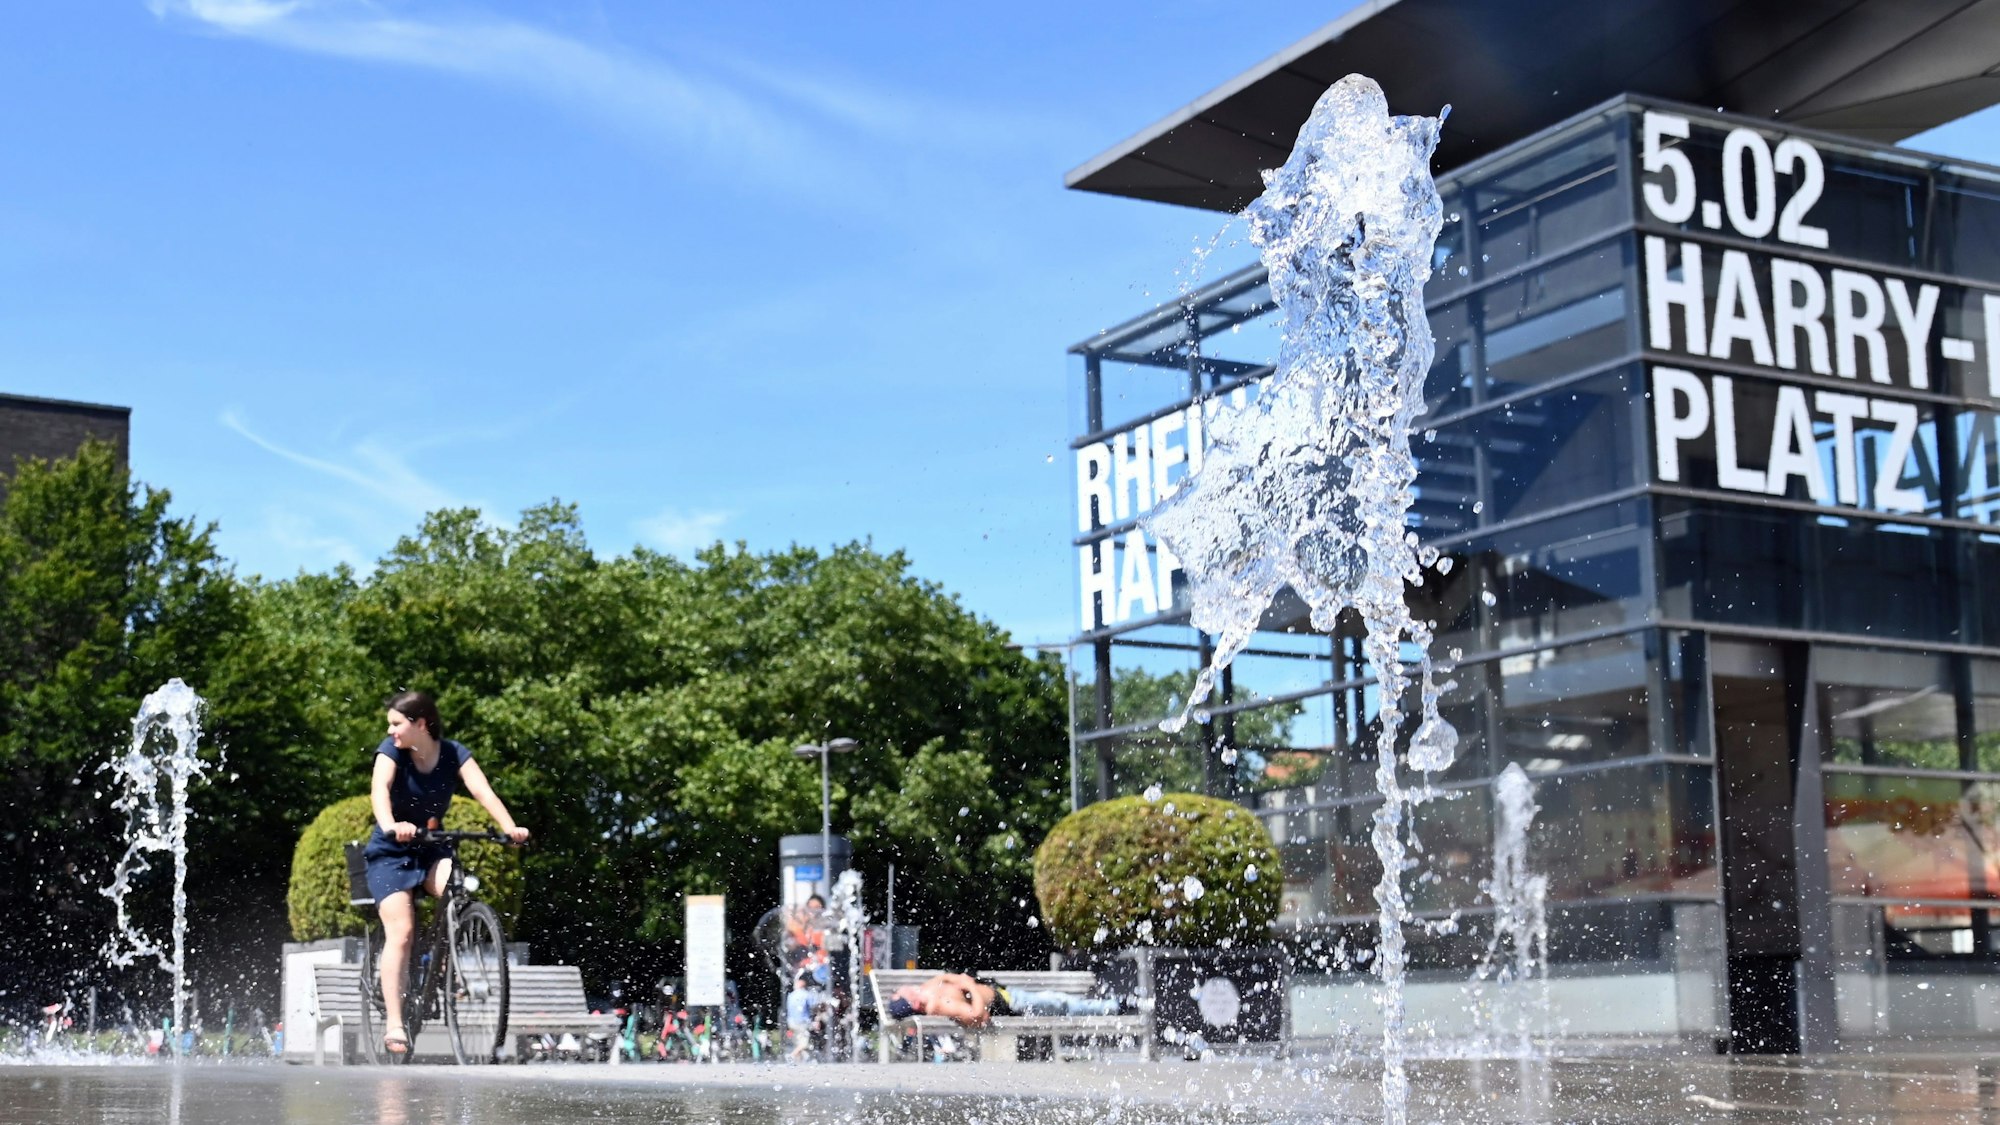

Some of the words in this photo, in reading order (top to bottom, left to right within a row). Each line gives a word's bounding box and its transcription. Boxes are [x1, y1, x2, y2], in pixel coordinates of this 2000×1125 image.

[1642, 112, 1829, 249] 5.02
[1077, 377, 1274, 532] RHEI
[1652, 366, 1925, 513] PLATZ
